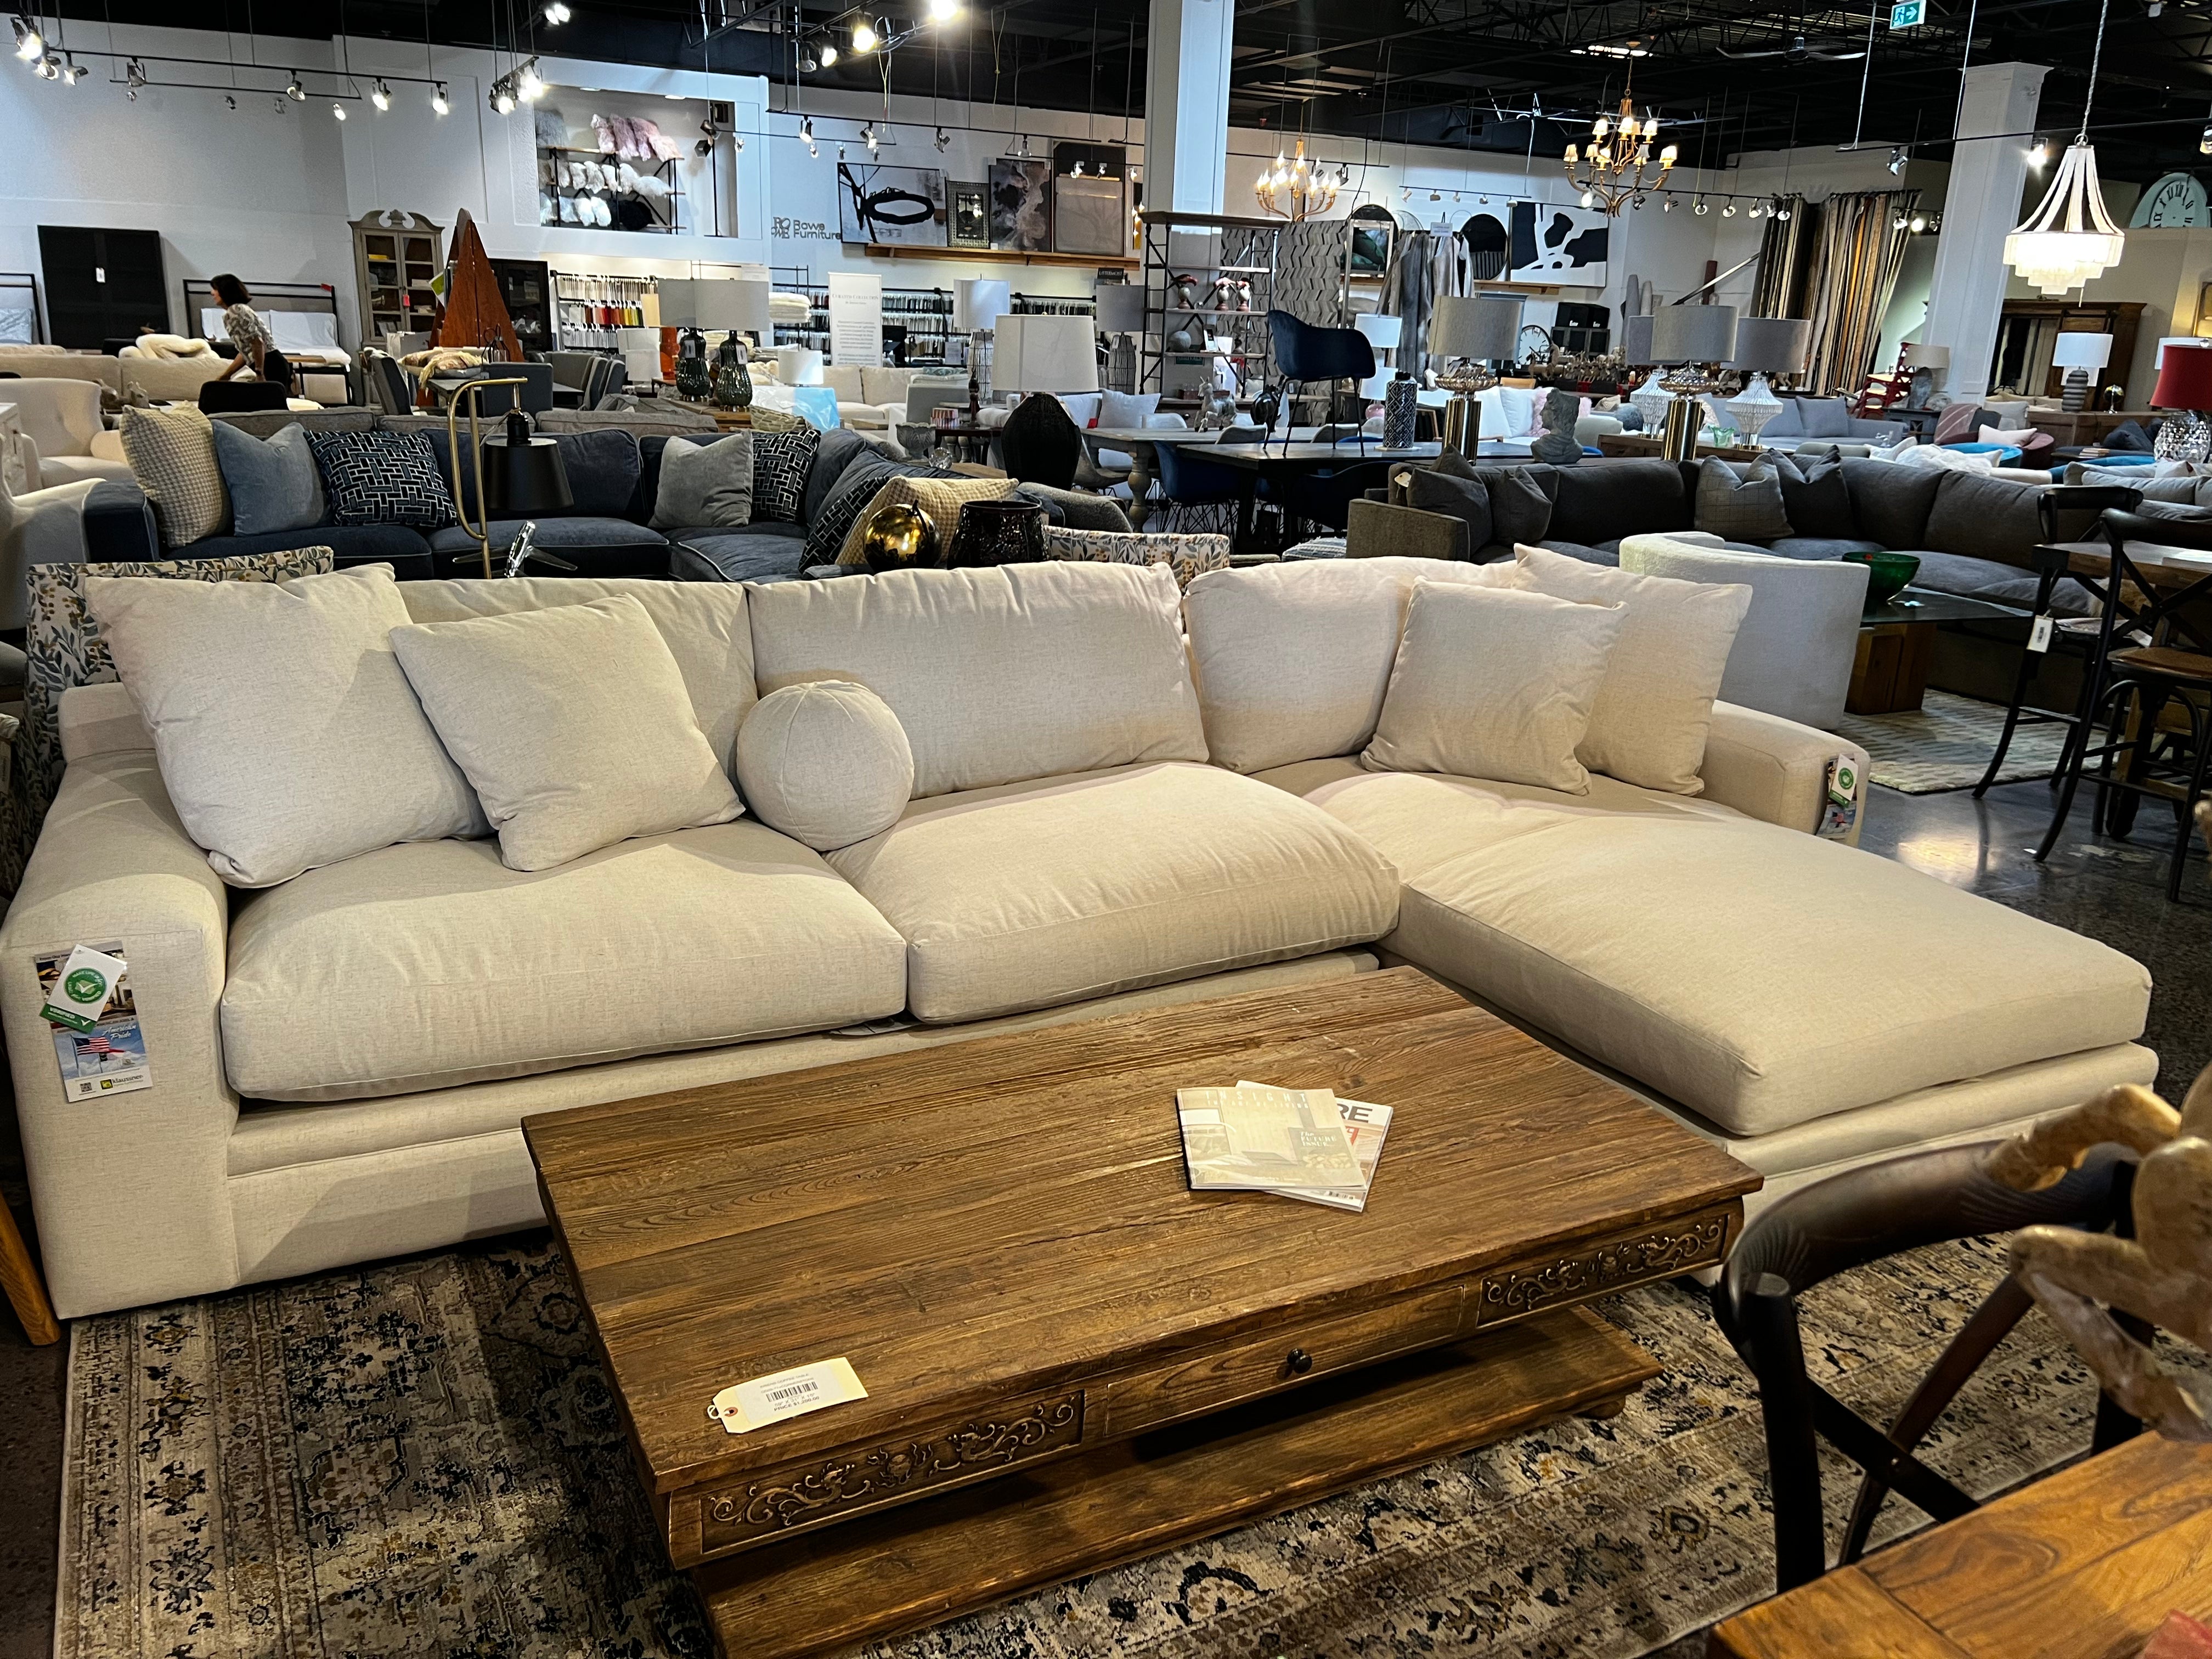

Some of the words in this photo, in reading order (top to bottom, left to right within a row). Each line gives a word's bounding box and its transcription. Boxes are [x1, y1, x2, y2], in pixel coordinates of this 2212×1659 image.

[794, 230, 842, 240] Furniture
[102, 1024, 137, 1036] American
[110, 1031, 132, 1040] Pride
[1205, 1090, 1306, 1102] INSIGHT
